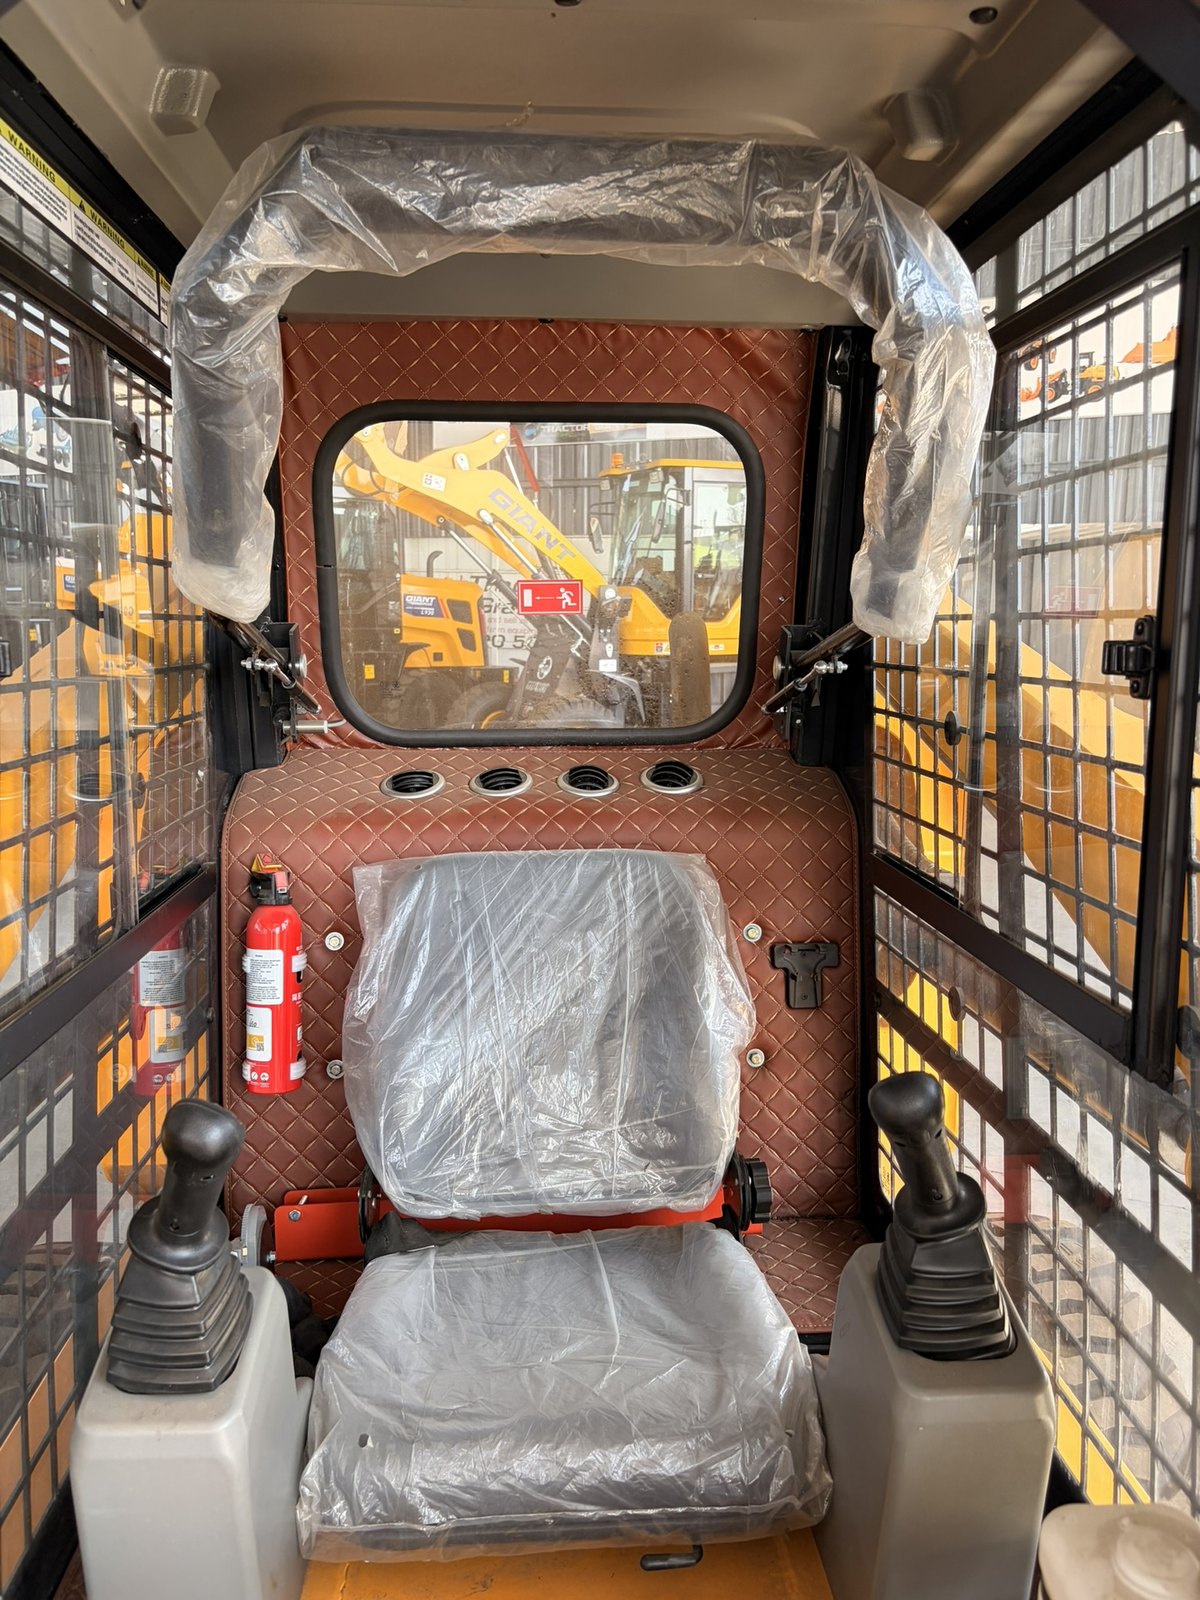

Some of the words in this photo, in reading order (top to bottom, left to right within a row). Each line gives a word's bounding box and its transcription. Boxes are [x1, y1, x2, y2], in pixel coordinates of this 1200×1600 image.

[8, 130, 56, 182] WARNING
[90, 209, 125, 249] WARNING
[488, 488, 576, 560] GIANT
[405, 595, 436, 603] GIANT
